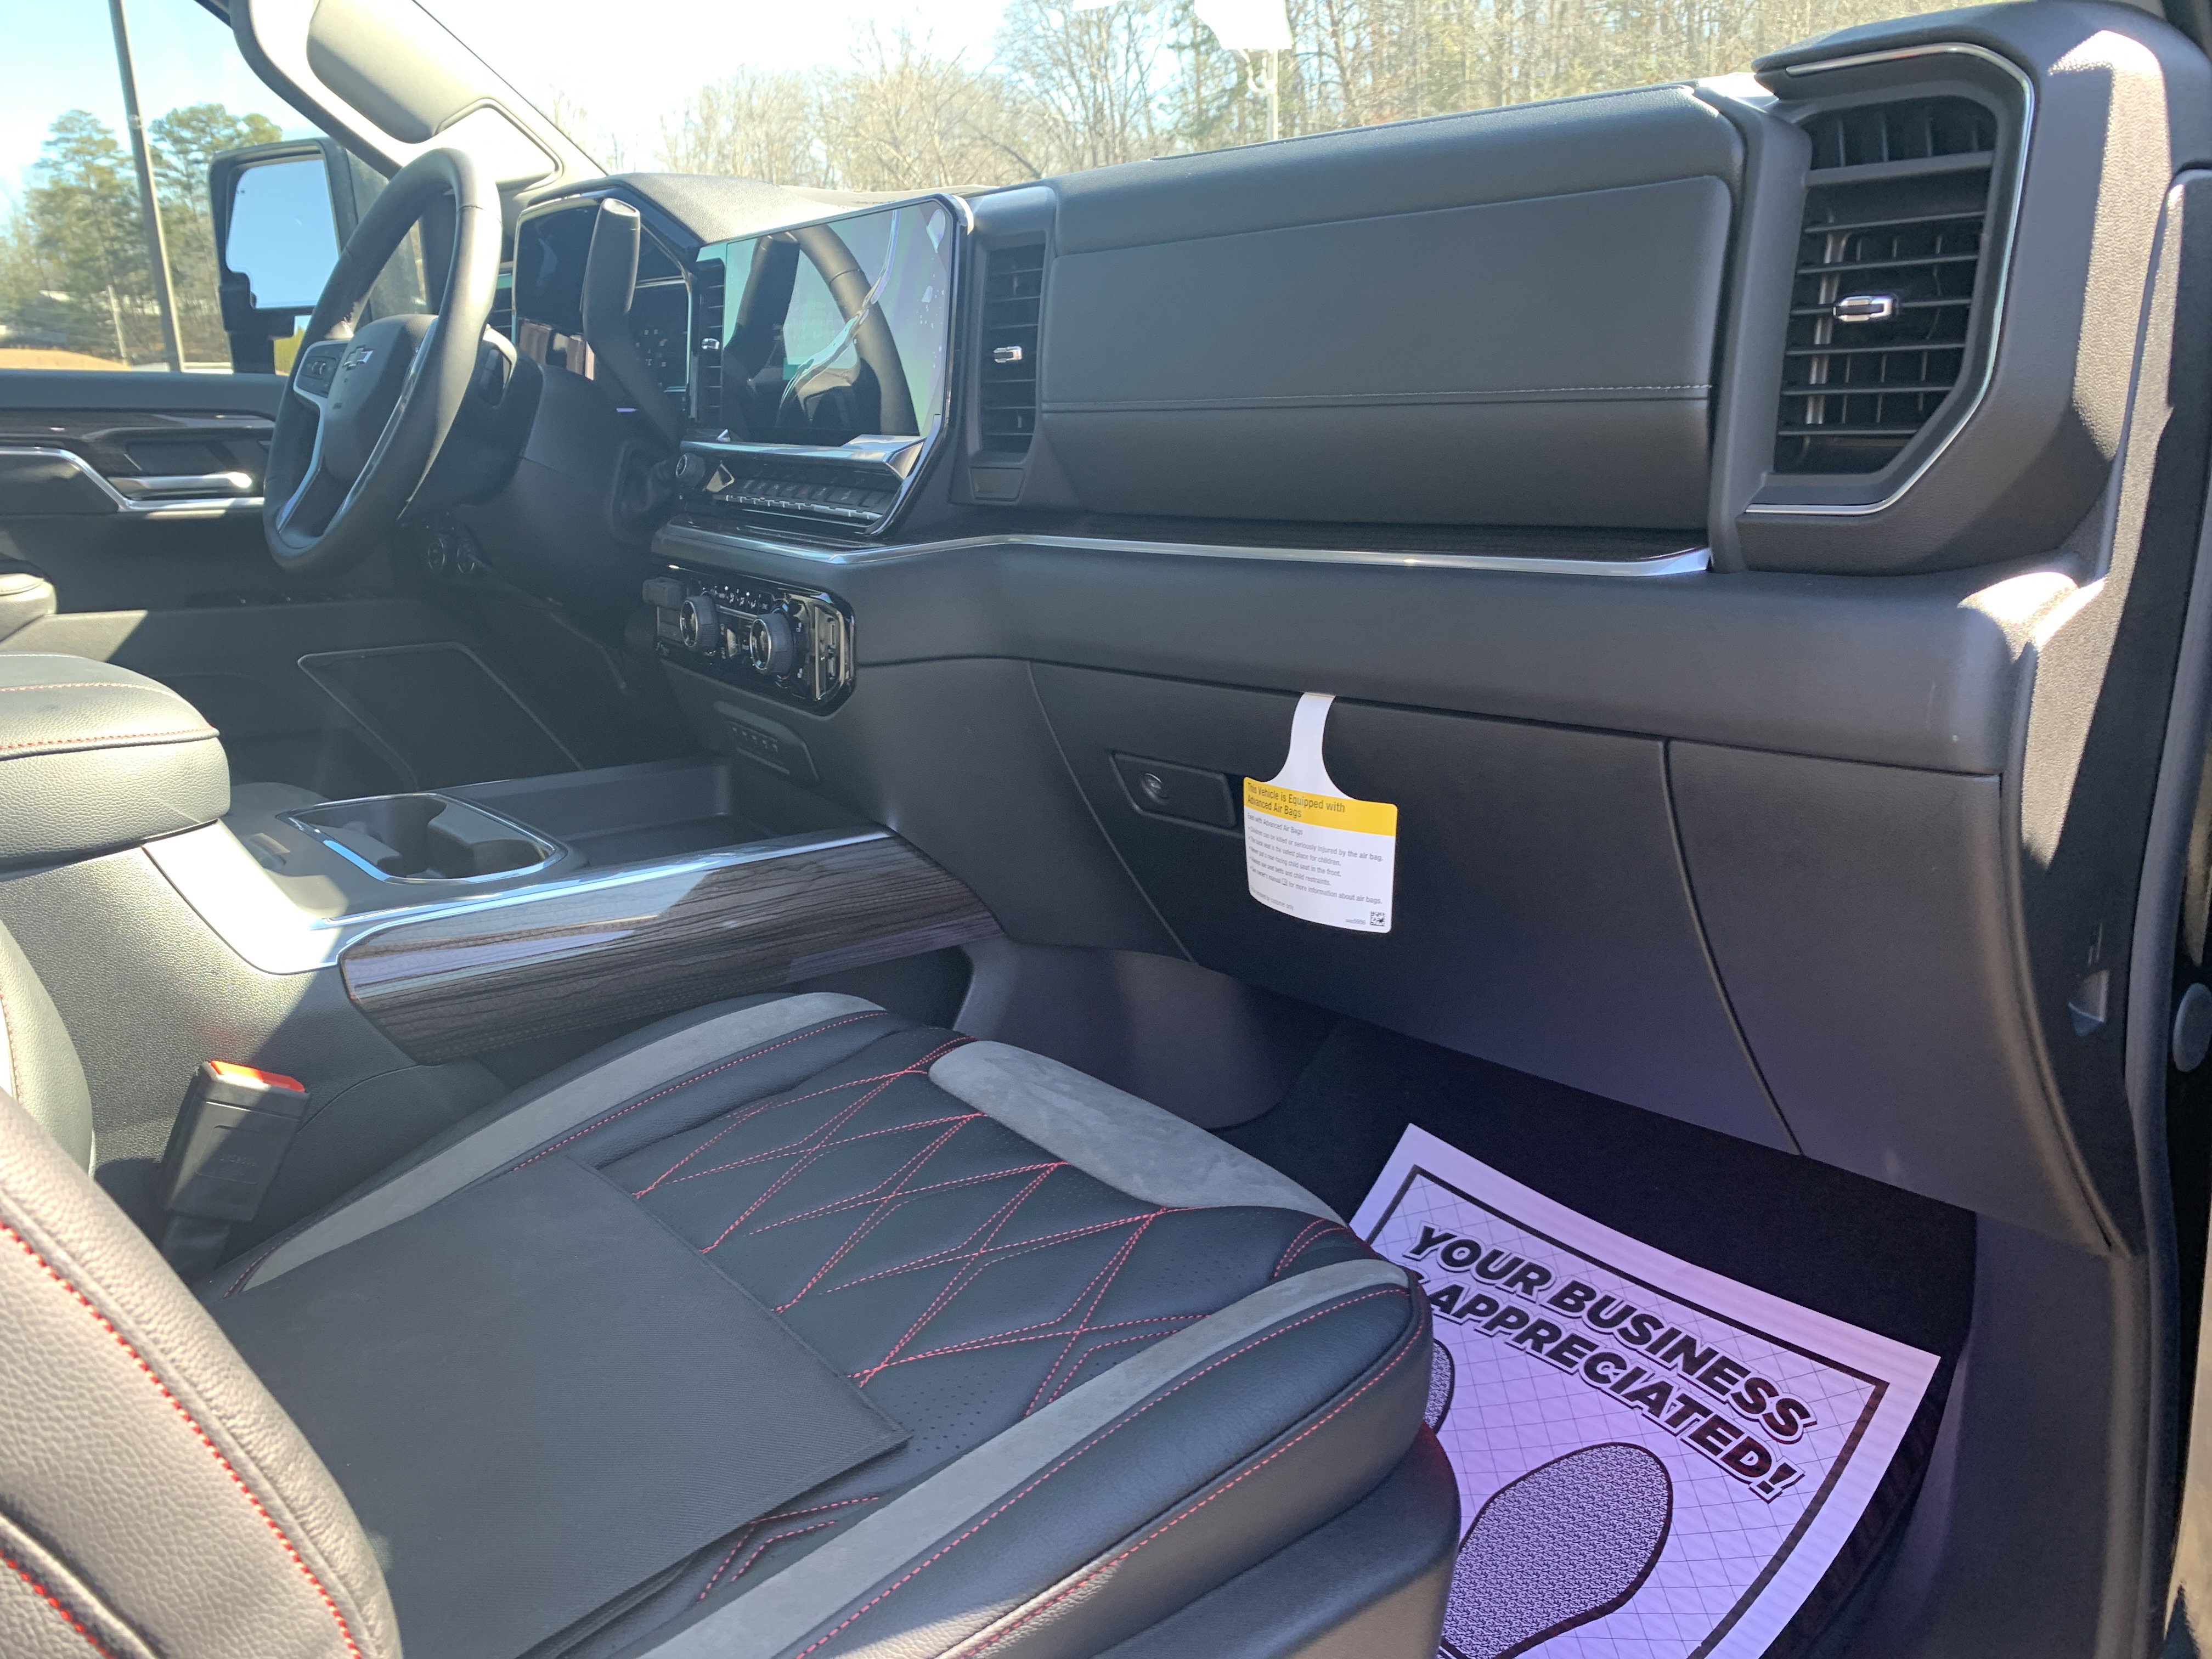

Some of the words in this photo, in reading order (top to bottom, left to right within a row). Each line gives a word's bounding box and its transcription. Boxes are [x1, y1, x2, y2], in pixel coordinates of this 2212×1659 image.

[1248, 782, 1257, 794] This
[1258, 786, 1279, 800] Vehicle
[1281, 792, 1286, 802] is
[1289, 794, 1324, 809] Equipped
[1326, 802, 1345, 812] with
[1248, 794, 1272, 810] Advanced
[1273, 803, 1283, 812] Air
[1284, 805, 1302, 819] Bags
[1263, 819, 1283, 830] Advanced
[1291, 826, 1303, 836] Bags
[1276, 836, 1288, 844] killed
[1294, 842, 1317, 851] seriously
[1318, 845, 1338, 854] injured
[1339, 849, 1346, 857] by
[1369, 853, 1384, 862] bag.
[1318, 856, 1341, 866] children.
[1327, 868, 1341, 877] front.
[1308, 885, 1338, 898] information
[1339, 893, 1355, 901] about
[1365, 896, 1383, 905] bags.
[1402, 1221, 1555, 1301] YOUR
[1545, 1277, 1816, 1444] BUSINESS
[1427, 1280, 1804, 1503] APPRECIATED!
